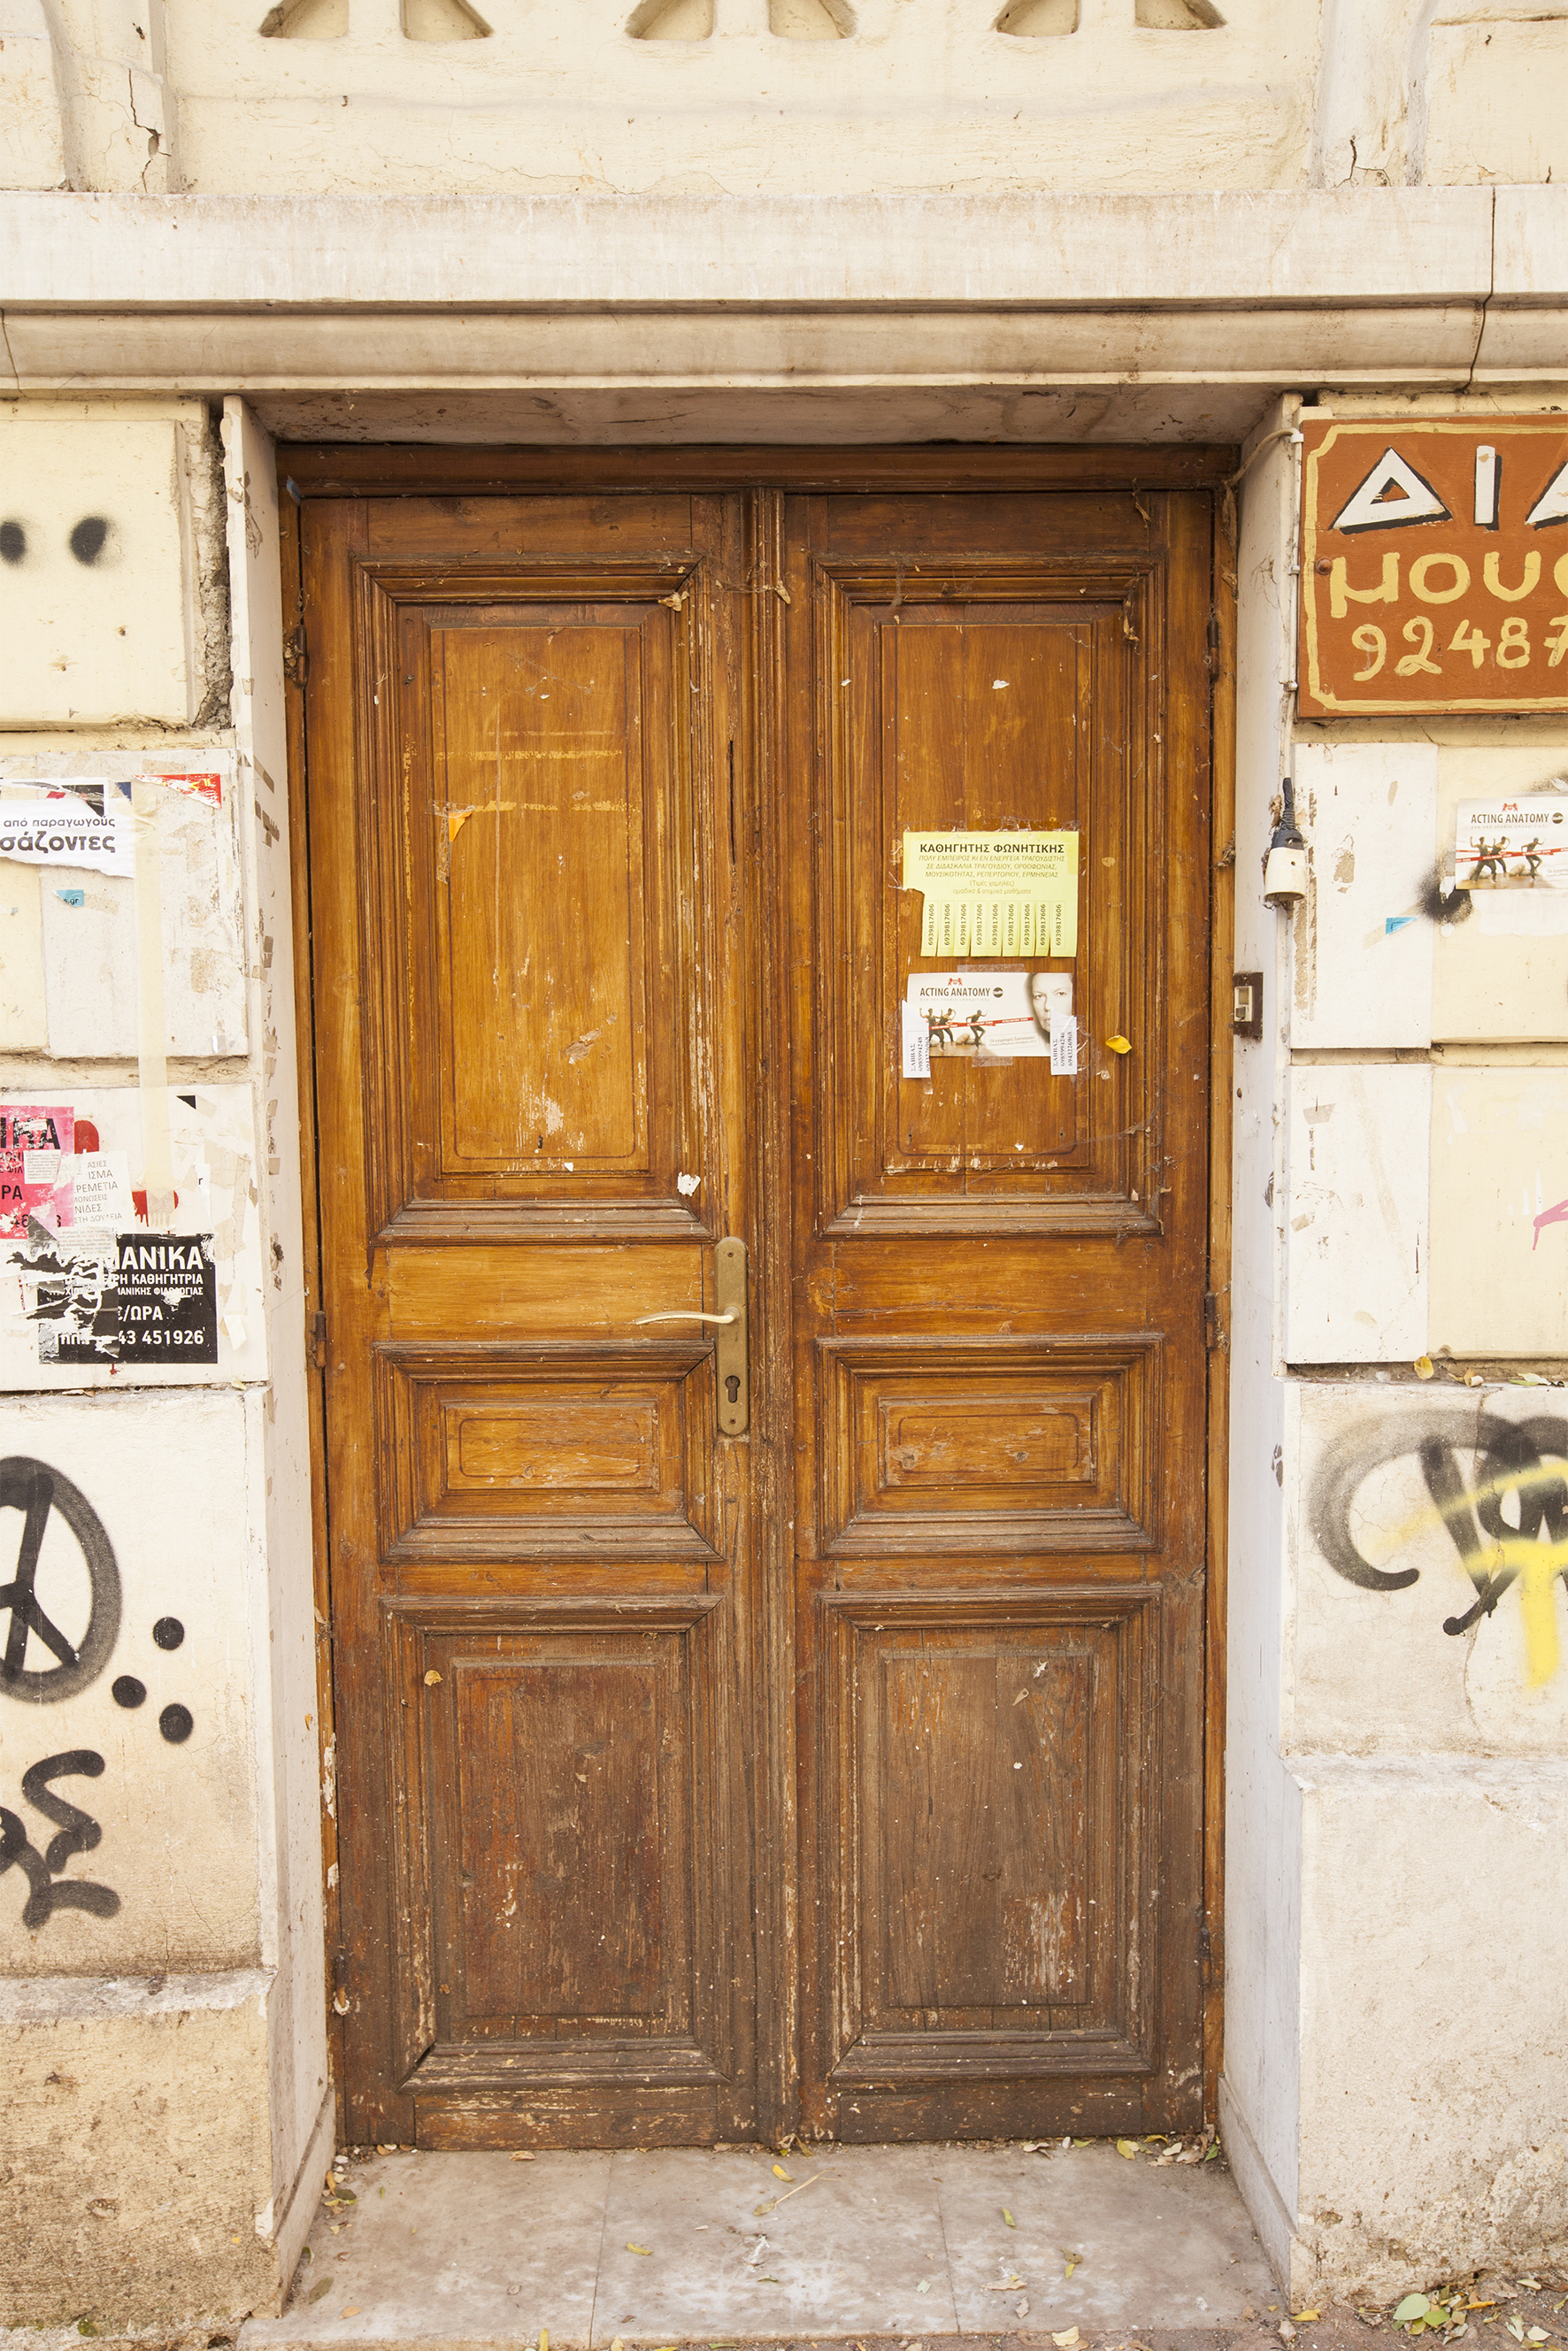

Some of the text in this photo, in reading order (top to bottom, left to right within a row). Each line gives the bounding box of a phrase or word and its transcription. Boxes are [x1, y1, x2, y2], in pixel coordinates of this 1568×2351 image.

[1330, 550, 1568, 618] μου
[4, 815, 115, 827] από παραγωγούς
[1471, 813, 1549, 824] ACTING ANATOMY
[919, 843, 1065, 854] ΚΑΘΗΓΗΤΗΣ ΦΩΝΗΤΙΚΗΣ
[919, 987, 949, 996] ACTING
[950, 987, 991, 996] ANATOMY
[87, 1160, 107, 1169] ΑΣΙΕΣ
[88, 1169, 113, 1179] ΙΣΜΑ
[73, 1181, 119, 1194] ΡΕΜΕΤΙΑ
[74, 1203, 103, 1214] ΝΙΔΕΣ
[131, 1273, 204, 1285] ΚΑΘΗΓΗΤΡΙΑ
[142, 1330, 204, 1345] 451926
